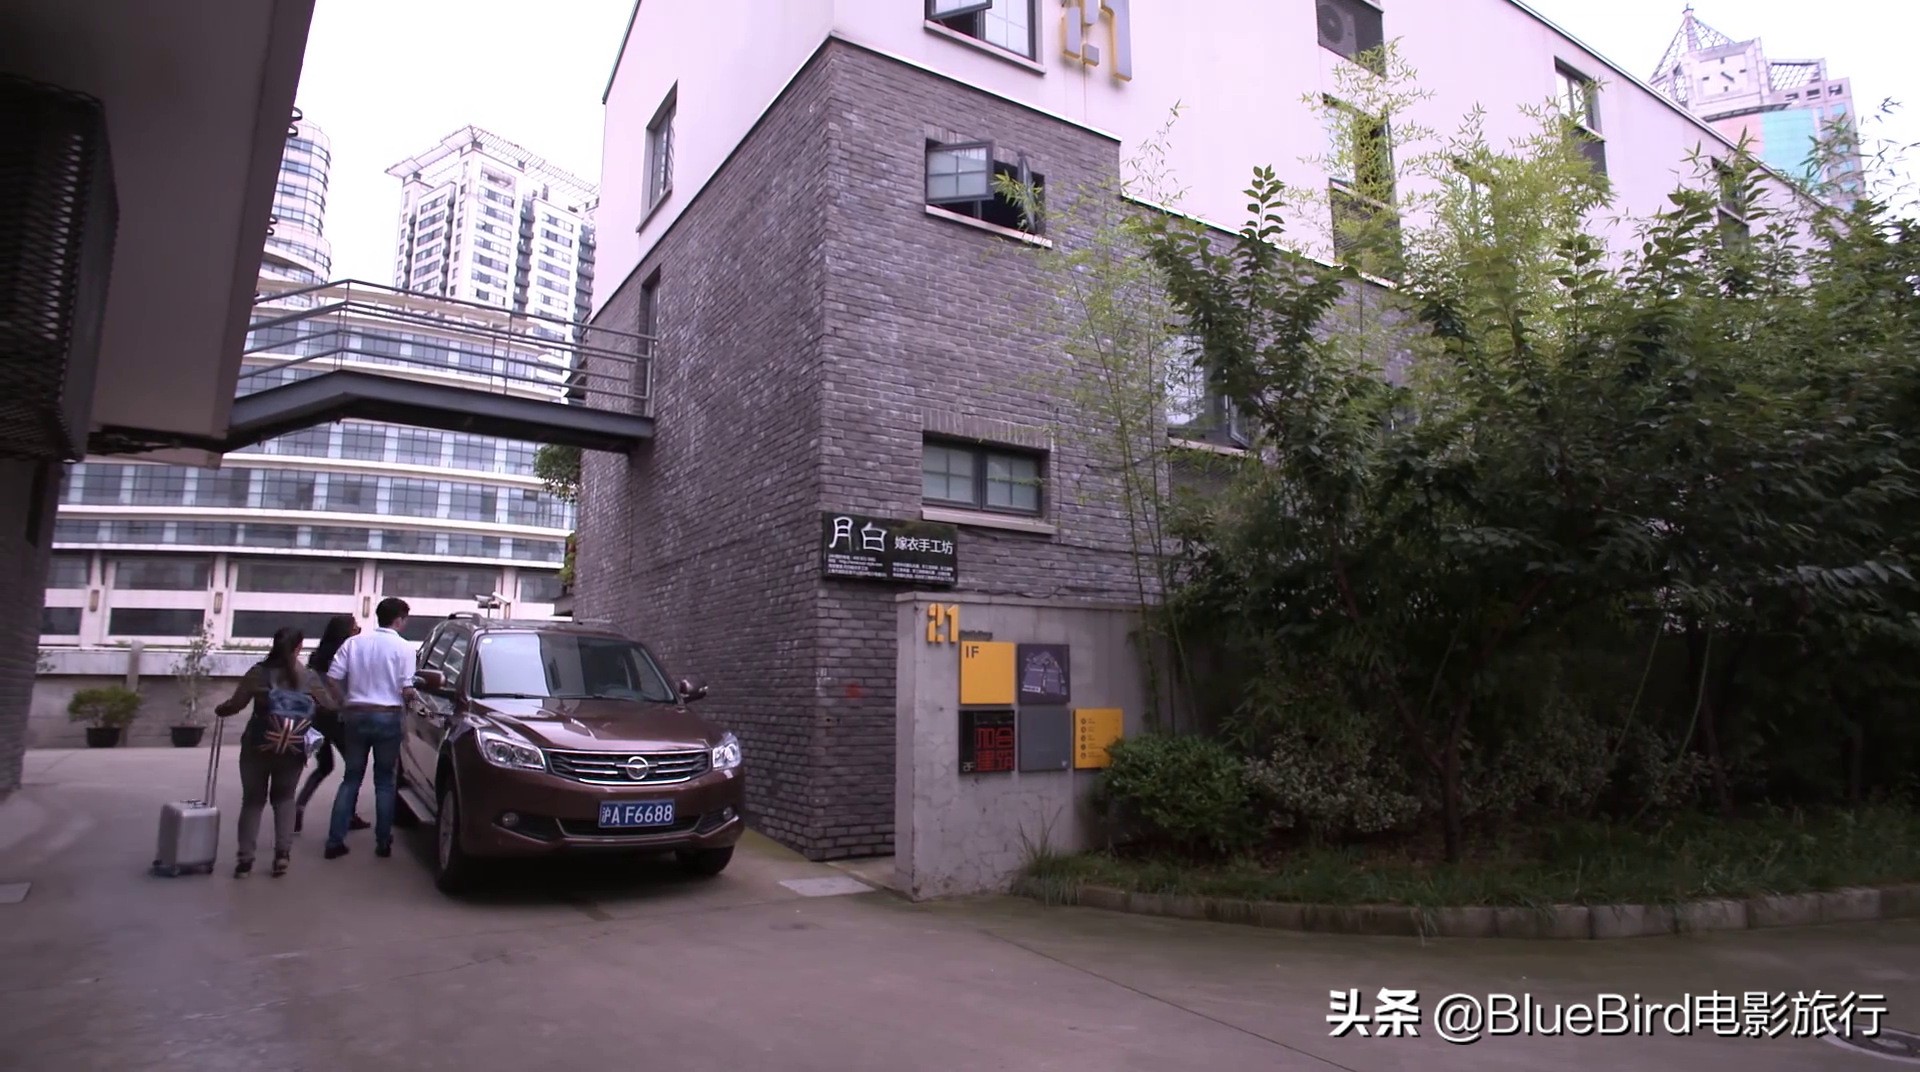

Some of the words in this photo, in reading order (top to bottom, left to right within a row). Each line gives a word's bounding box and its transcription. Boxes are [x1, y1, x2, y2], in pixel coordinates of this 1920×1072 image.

[829, 516, 887, 552] 月白
[895, 536, 953, 555] 嫁衣手工坊
[928, 603, 959, 643] 21
